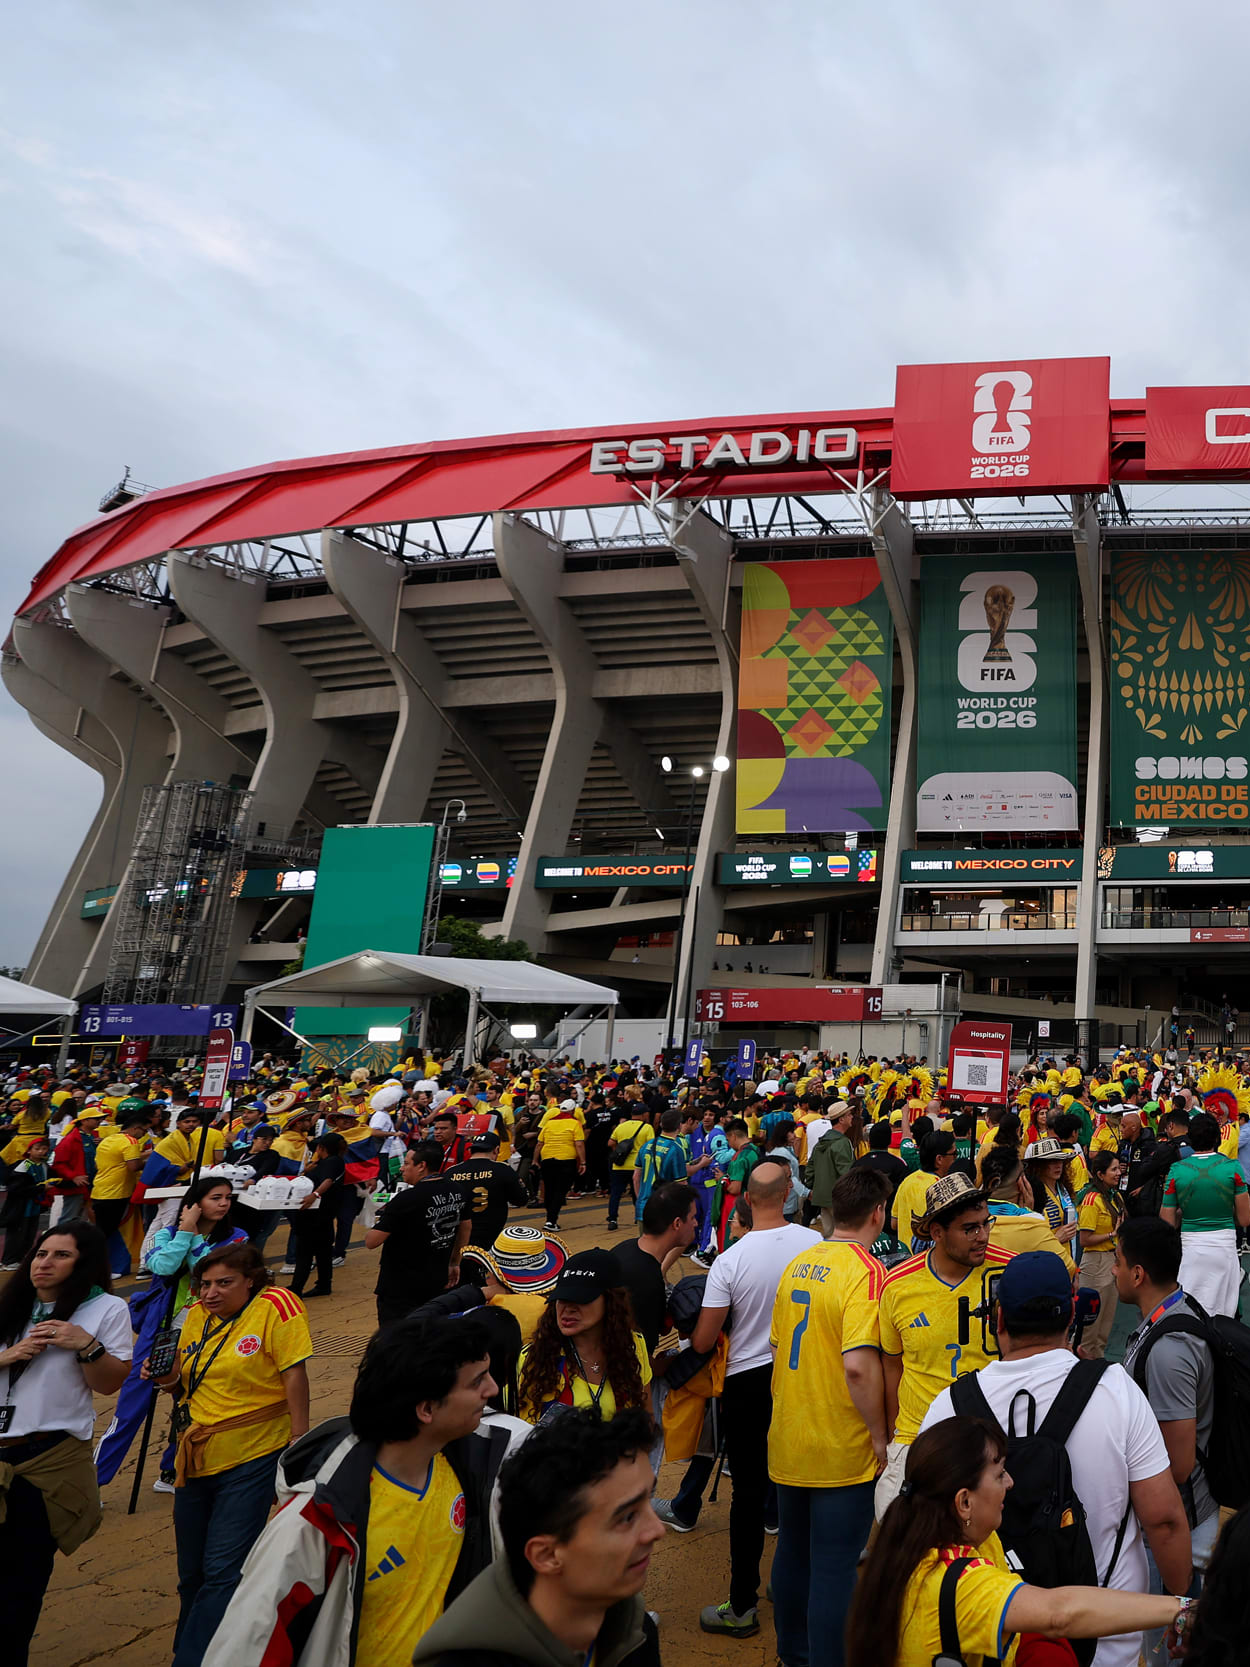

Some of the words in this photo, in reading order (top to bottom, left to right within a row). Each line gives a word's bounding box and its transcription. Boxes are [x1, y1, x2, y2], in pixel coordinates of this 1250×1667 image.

[988, 436, 1015, 445] FIFA
[590, 427, 858, 475] ESTADIO
[971, 456, 1008, 465] WORLD
[1009, 455, 1030, 463] CUP
[970, 464, 1030, 478] 2026
[980, 668, 1016, 681] FIFA
[957, 698, 1007, 709] WORLD
[1009, 697, 1037, 708] CUP
[956, 710, 1037, 729] 2026
[1135, 756, 1248, 780] SOMOS
[1135, 785, 1217, 801] CIUDAD
[1221, 785, 1248, 800] DE
[1135, 801, 1248, 820] MÉXICO
[584, 866, 651, 876] MEXICO
[762, 864, 776, 872] CUP
[955, 859, 1028, 871] MEXICO
[1031, 858, 1074, 870] CITY
[706, 1002, 724, 1019] 15
[868, 996, 882, 1012] 15
[84, 1016, 100, 1032] 13
[212, 1012, 233, 1028] 13
[970, 1030, 1006, 1040] Hospitality
[127, 1046, 136, 1055] 13
[450, 1172, 472, 1182] JOSE
[474, 1170, 493, 1180] LUIS
[472, 1186, 488, 1212] 3
[792, 1264, 811, 1279] LUIS
[788, 1289, 811, 1370] 7
[945, 1343, 962, 1378] 7
